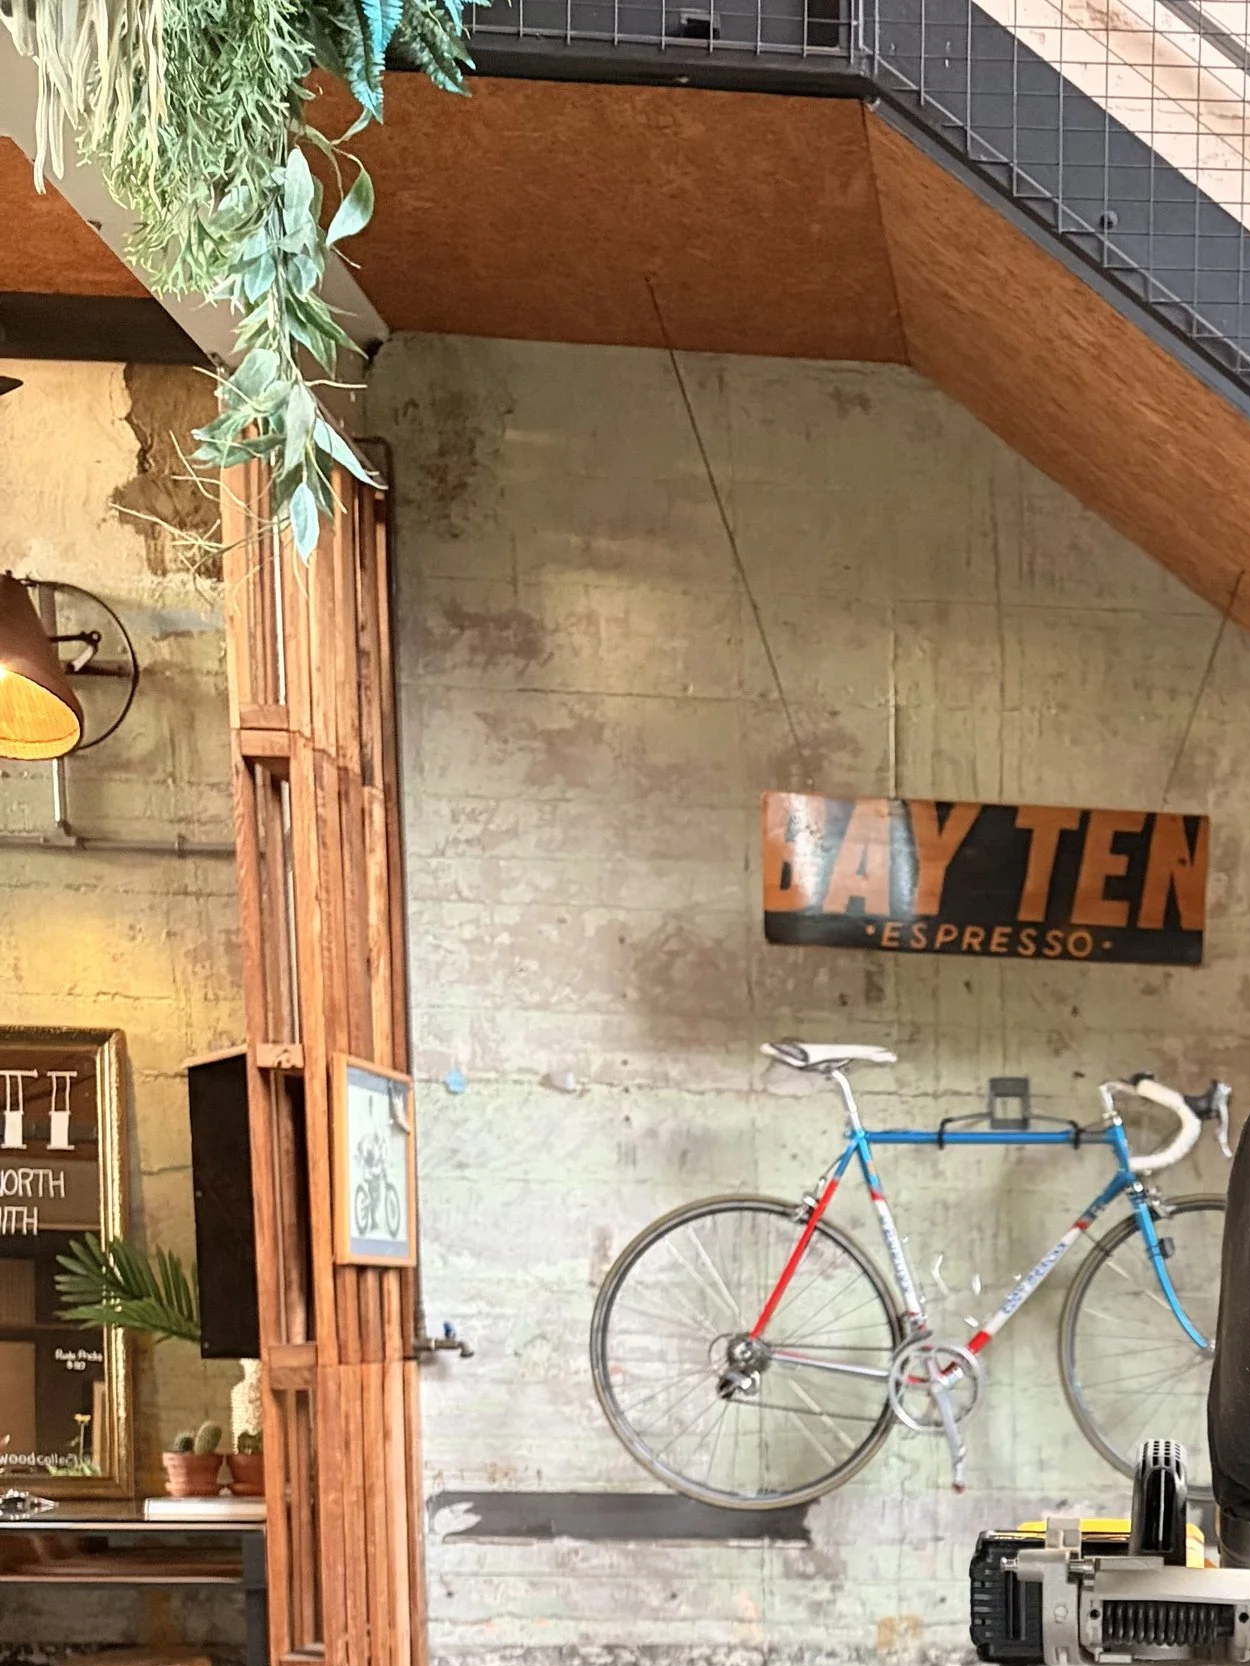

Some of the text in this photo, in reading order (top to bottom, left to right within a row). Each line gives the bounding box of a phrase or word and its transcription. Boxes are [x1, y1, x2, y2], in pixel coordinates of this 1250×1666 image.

[763, 792, 1209, 930] BAY TEN
[880, 921, 1093, 959] ESPRESSO
[0, 1168, 65, 1198] ORTH
[0, 1206, 38, 1235] ITH
